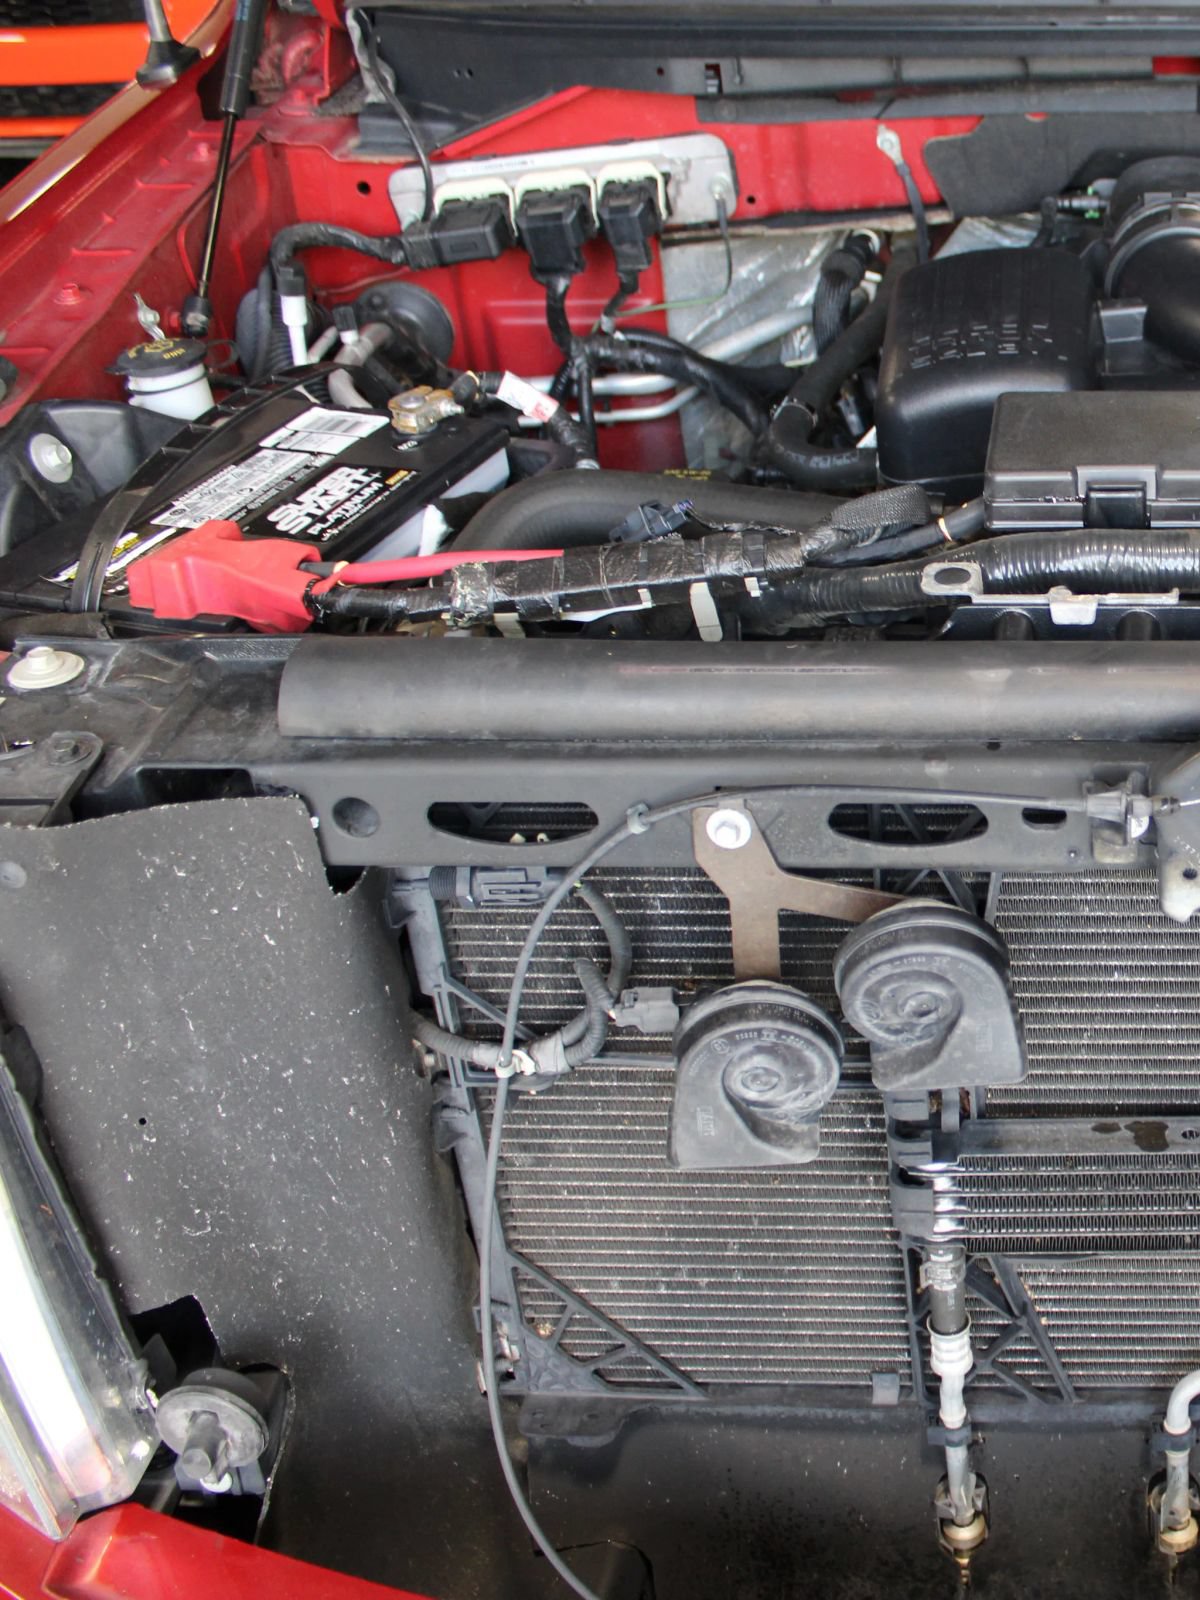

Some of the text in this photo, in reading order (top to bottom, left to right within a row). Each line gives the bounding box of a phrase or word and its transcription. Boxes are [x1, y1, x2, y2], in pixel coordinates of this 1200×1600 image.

[267, 466, 361, 522] SUPER
[275, 468, 369, 535] START
[306, 481, 384, 535] PLATINUM
